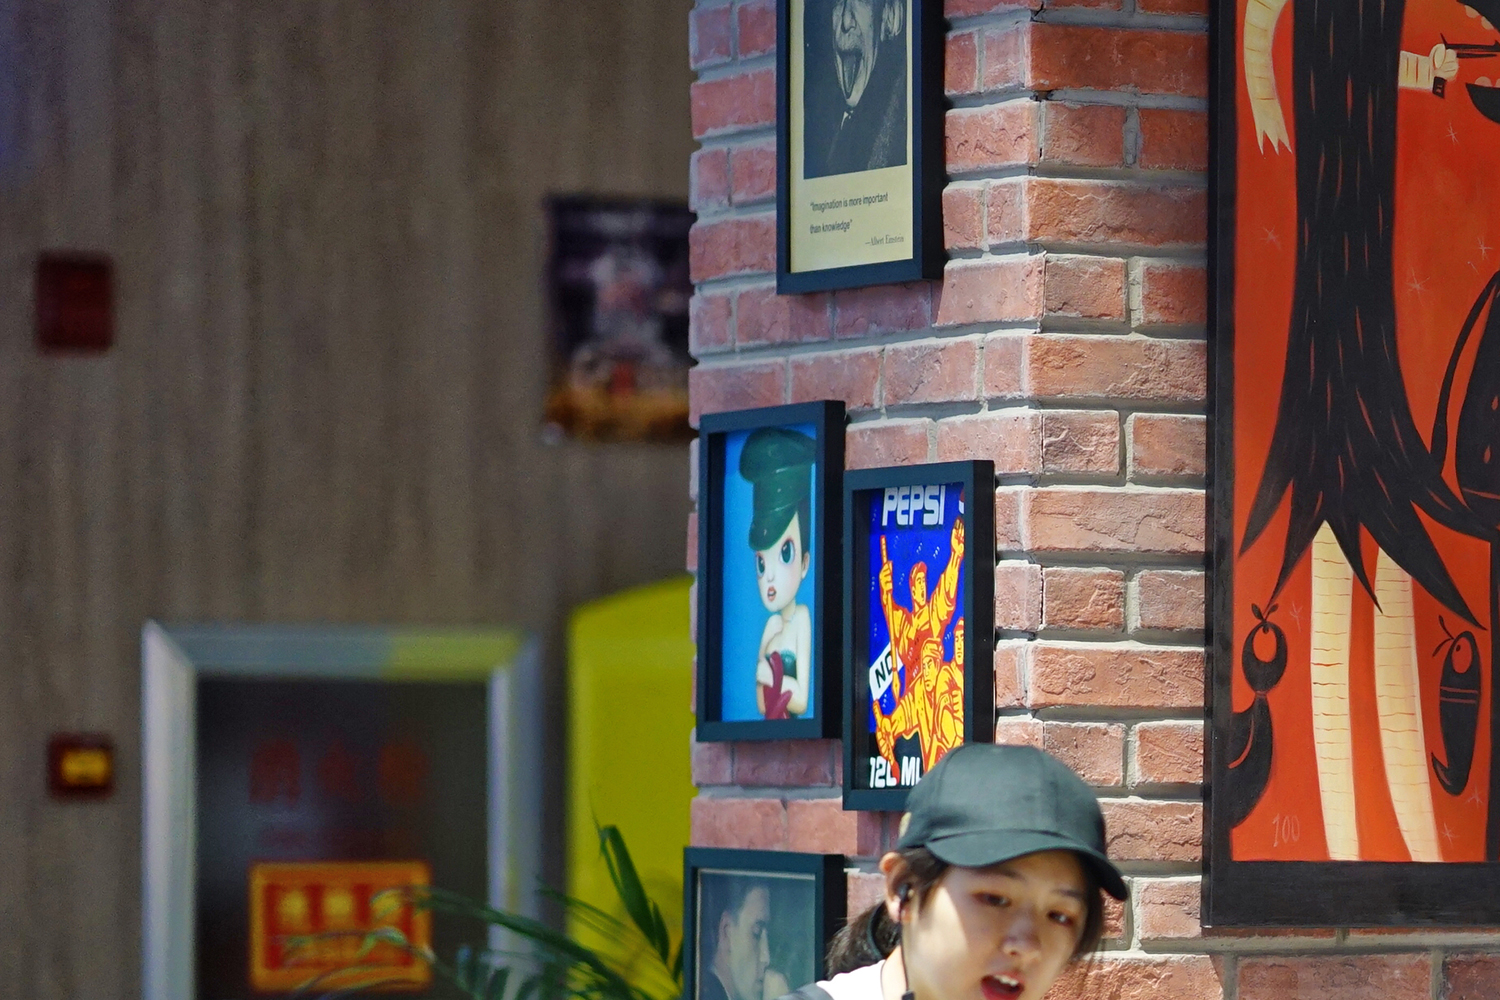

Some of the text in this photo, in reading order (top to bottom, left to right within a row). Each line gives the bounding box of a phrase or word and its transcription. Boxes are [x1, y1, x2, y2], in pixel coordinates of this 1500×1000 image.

[849, 197, 862, 206] more
[863, 192, 889, 206] important
[810, 223, 821, 234] than
[882, 485, 946, 526] PEPSI
